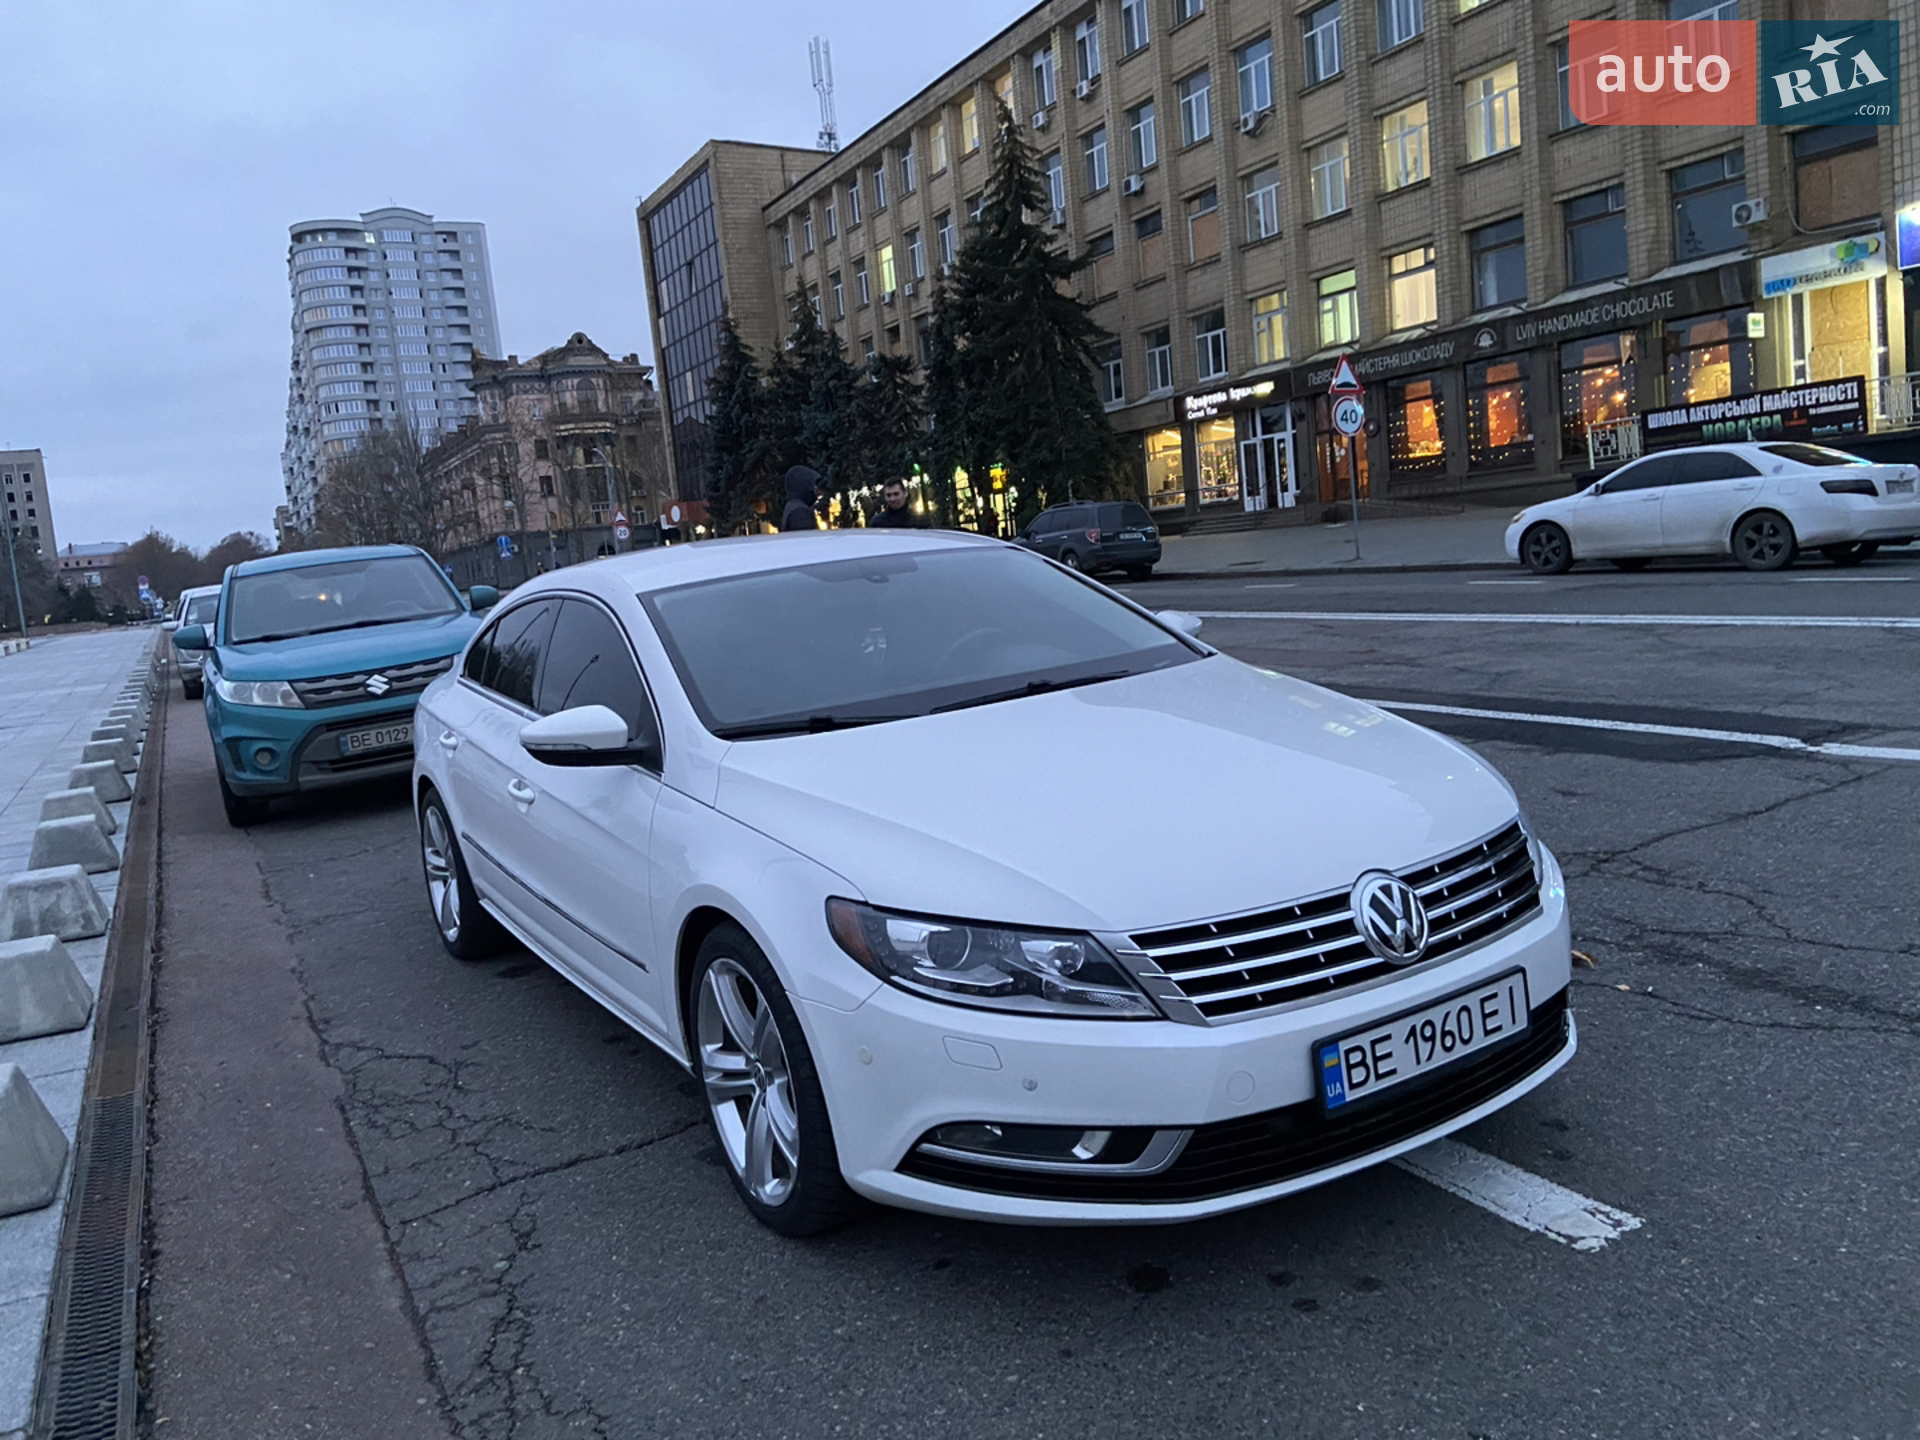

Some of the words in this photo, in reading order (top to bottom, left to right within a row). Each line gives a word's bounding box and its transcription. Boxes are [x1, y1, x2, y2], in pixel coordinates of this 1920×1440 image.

[1515, 320, 1538, 341] LVIV
[1538, 306, 1600, 335] HANDMADE
[1602, 290, 1674, 322] CHOCOLATE
[1400, 341, 1456, 366] ШОКОЛАДУ
[1340, 409, 1358, 425] 40
[1647, 407, 1689, 429] ШКОЛА
[1689, 394, 1762, 423] АКТОРСЬКОЇ
[1762, 381, 1859, 412] МАЙСТЕРНОСТІ
[349, 732, 372, 749] BE
[375, 727, 409, 744] 0129
[1344, 1034, 1397, 1091] BE
[1404, 1004, 1474, 1066] 1960
[1479, 985, 1517, 1038] EI
[1327, 1081, 1343, 1098] UA
